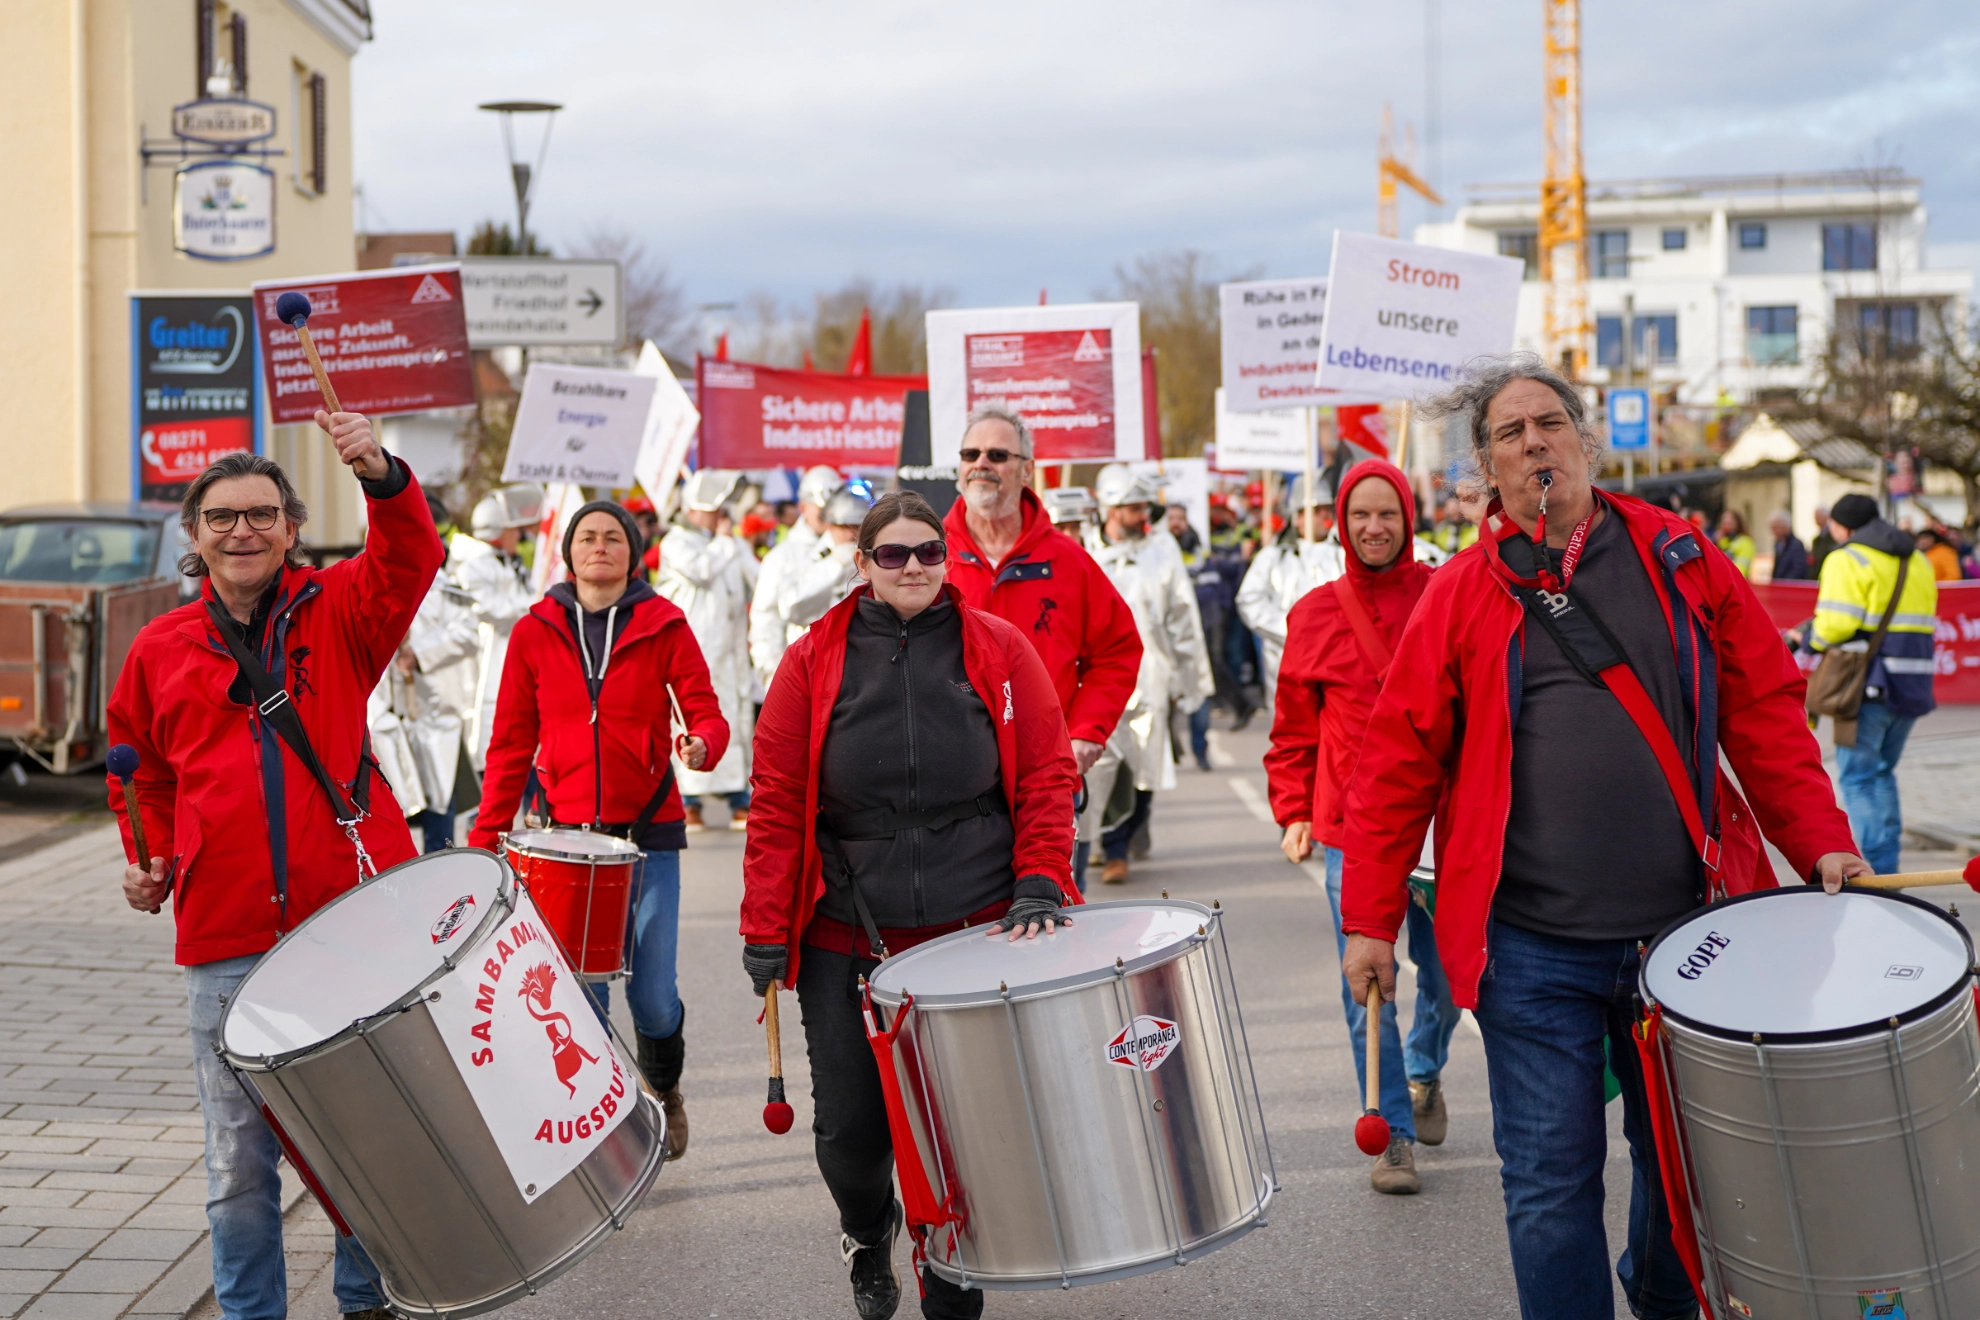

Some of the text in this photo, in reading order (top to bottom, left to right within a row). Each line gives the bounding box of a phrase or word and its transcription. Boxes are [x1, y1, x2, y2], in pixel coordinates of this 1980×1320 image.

[1387, 258, 1460, 291] Strom
[1243, 290, 1286, 306] Ruhe
[339, 319, 394, 338] Arbeit
[1377, 308, 1459, 337] unsere
[272, 335, 414, 361] auc in Zukunft.
[273, 347, 448, 378] Indutriestrompreis
[552, 380, 628, 399] Bezahlbare
[145, 397, 248, 411] MEITINGEN
[761, 395, 846, 422] Sichere
[557, 409, 608, 428] Energie
[158, 428, 207, 451] 08271
[566, 436, 587, 452] für
[518, 462, 620, 482] Stahl & Chemie
[1677, 930, 1731, 980] GOPE
[534, 1039, 625, 1144] AUGSBURG
